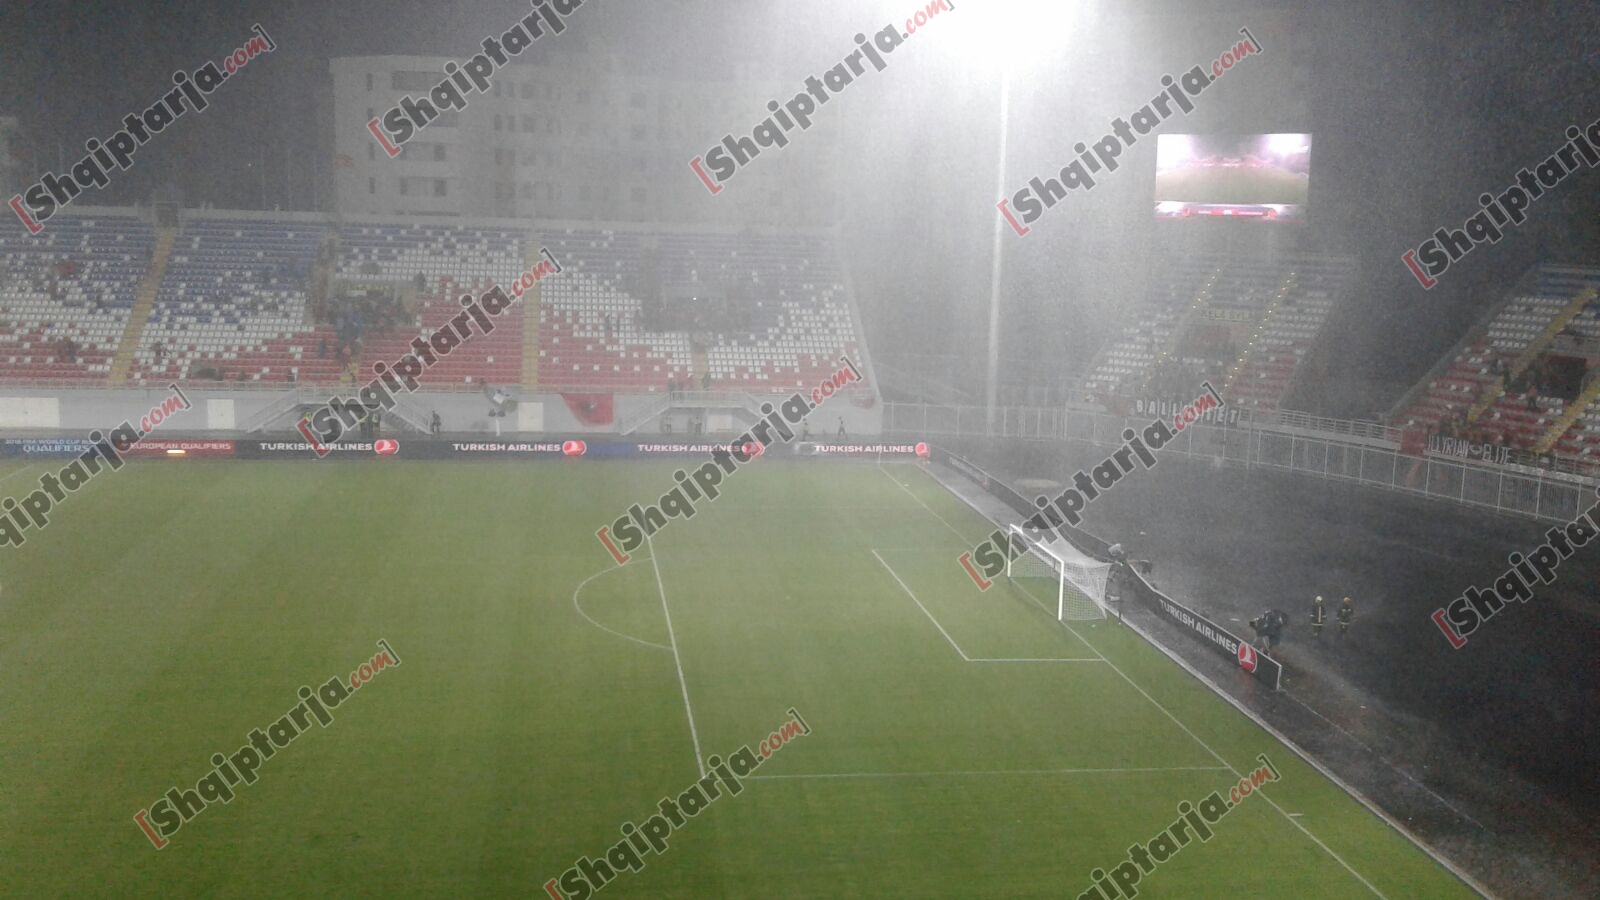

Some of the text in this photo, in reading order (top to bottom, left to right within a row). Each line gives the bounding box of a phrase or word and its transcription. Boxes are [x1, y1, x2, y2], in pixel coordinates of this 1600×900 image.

[260, 442, 373, 451] TURKISH AIRLINES
[452, 443, 561, 452] TURKISH AIRLINES
[637, 444, 740, 452] TURKISH AIRLINES
[814, 445, 914, 453] TURKISH AIRLINES
[1158, 598, 1238, 655] TURKISH AIRLINES
